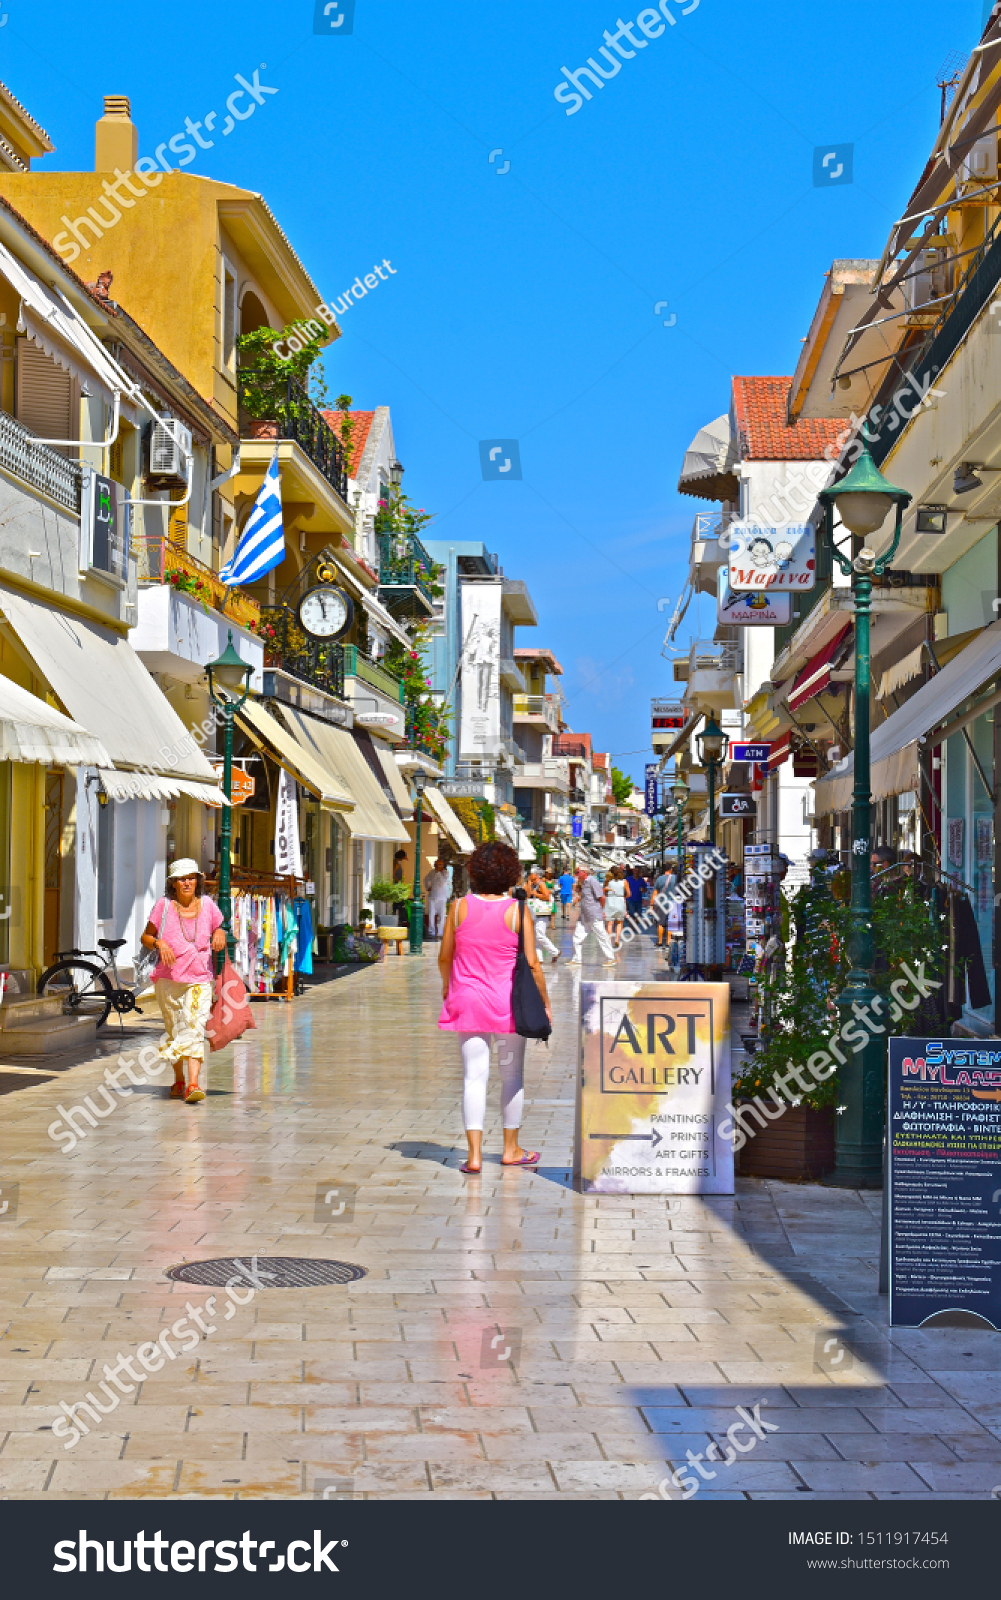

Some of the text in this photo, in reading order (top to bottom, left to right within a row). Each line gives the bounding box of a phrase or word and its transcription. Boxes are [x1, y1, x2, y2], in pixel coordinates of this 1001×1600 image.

[744, 749, 763, 757] ATM
[609, 1013, 706, 1055] ART
[608, 1066, 704, 1085] GALLERY
[650, 1114, 709, 1123] PAINTINGS
[670, 1132, 709, 1141] PRINTS
[655, 1150, 709, 1159] ART GIFTS
[601, 1167, 710, 1177] MIRRORS & FRAMES
